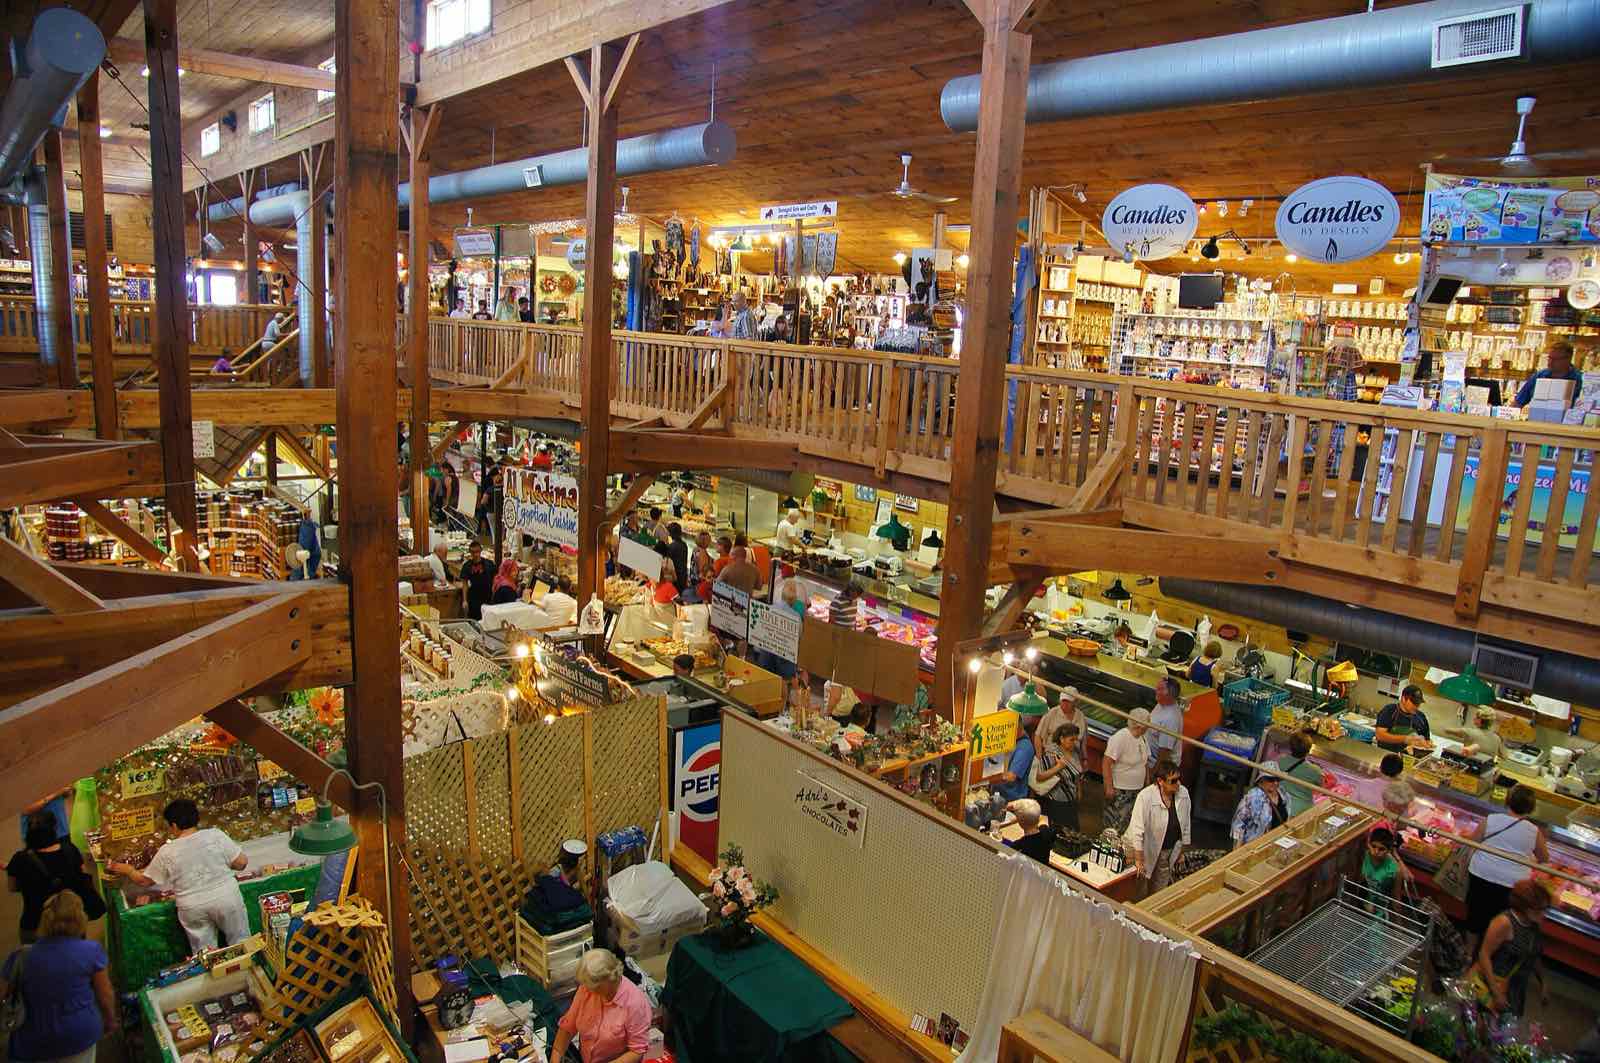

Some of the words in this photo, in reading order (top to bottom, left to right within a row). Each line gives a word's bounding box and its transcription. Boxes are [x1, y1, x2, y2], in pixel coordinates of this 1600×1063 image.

[1111, 204, 1187, 225] Candles
[1287, 200, 1385, 225] Candles
[1122, 226, 1133, 234] BY
[1137, 226, 1176, 235] DESIGN
[1301, 227, 1313, 236] BY
[1321, 226, 1370, 235] DESIGN
[505, 468, 518, 497] Al
[520, 470, 578, 512] Medina
[515, 496, 548, 525] Egyptian
[548, 504, 577, 534] Cuisine
[579, 675, 603, 693] Farms
[987, 722, 1015, 734] Ontario
[987, 732, 1008, 743] Maple
[984, 742, 1008, 752] Syrup
[681, 773, 720, 797] PEP
[795, 786, 829, 803] Adri's
[801, 804, 848, 836] CHOCOLATES
